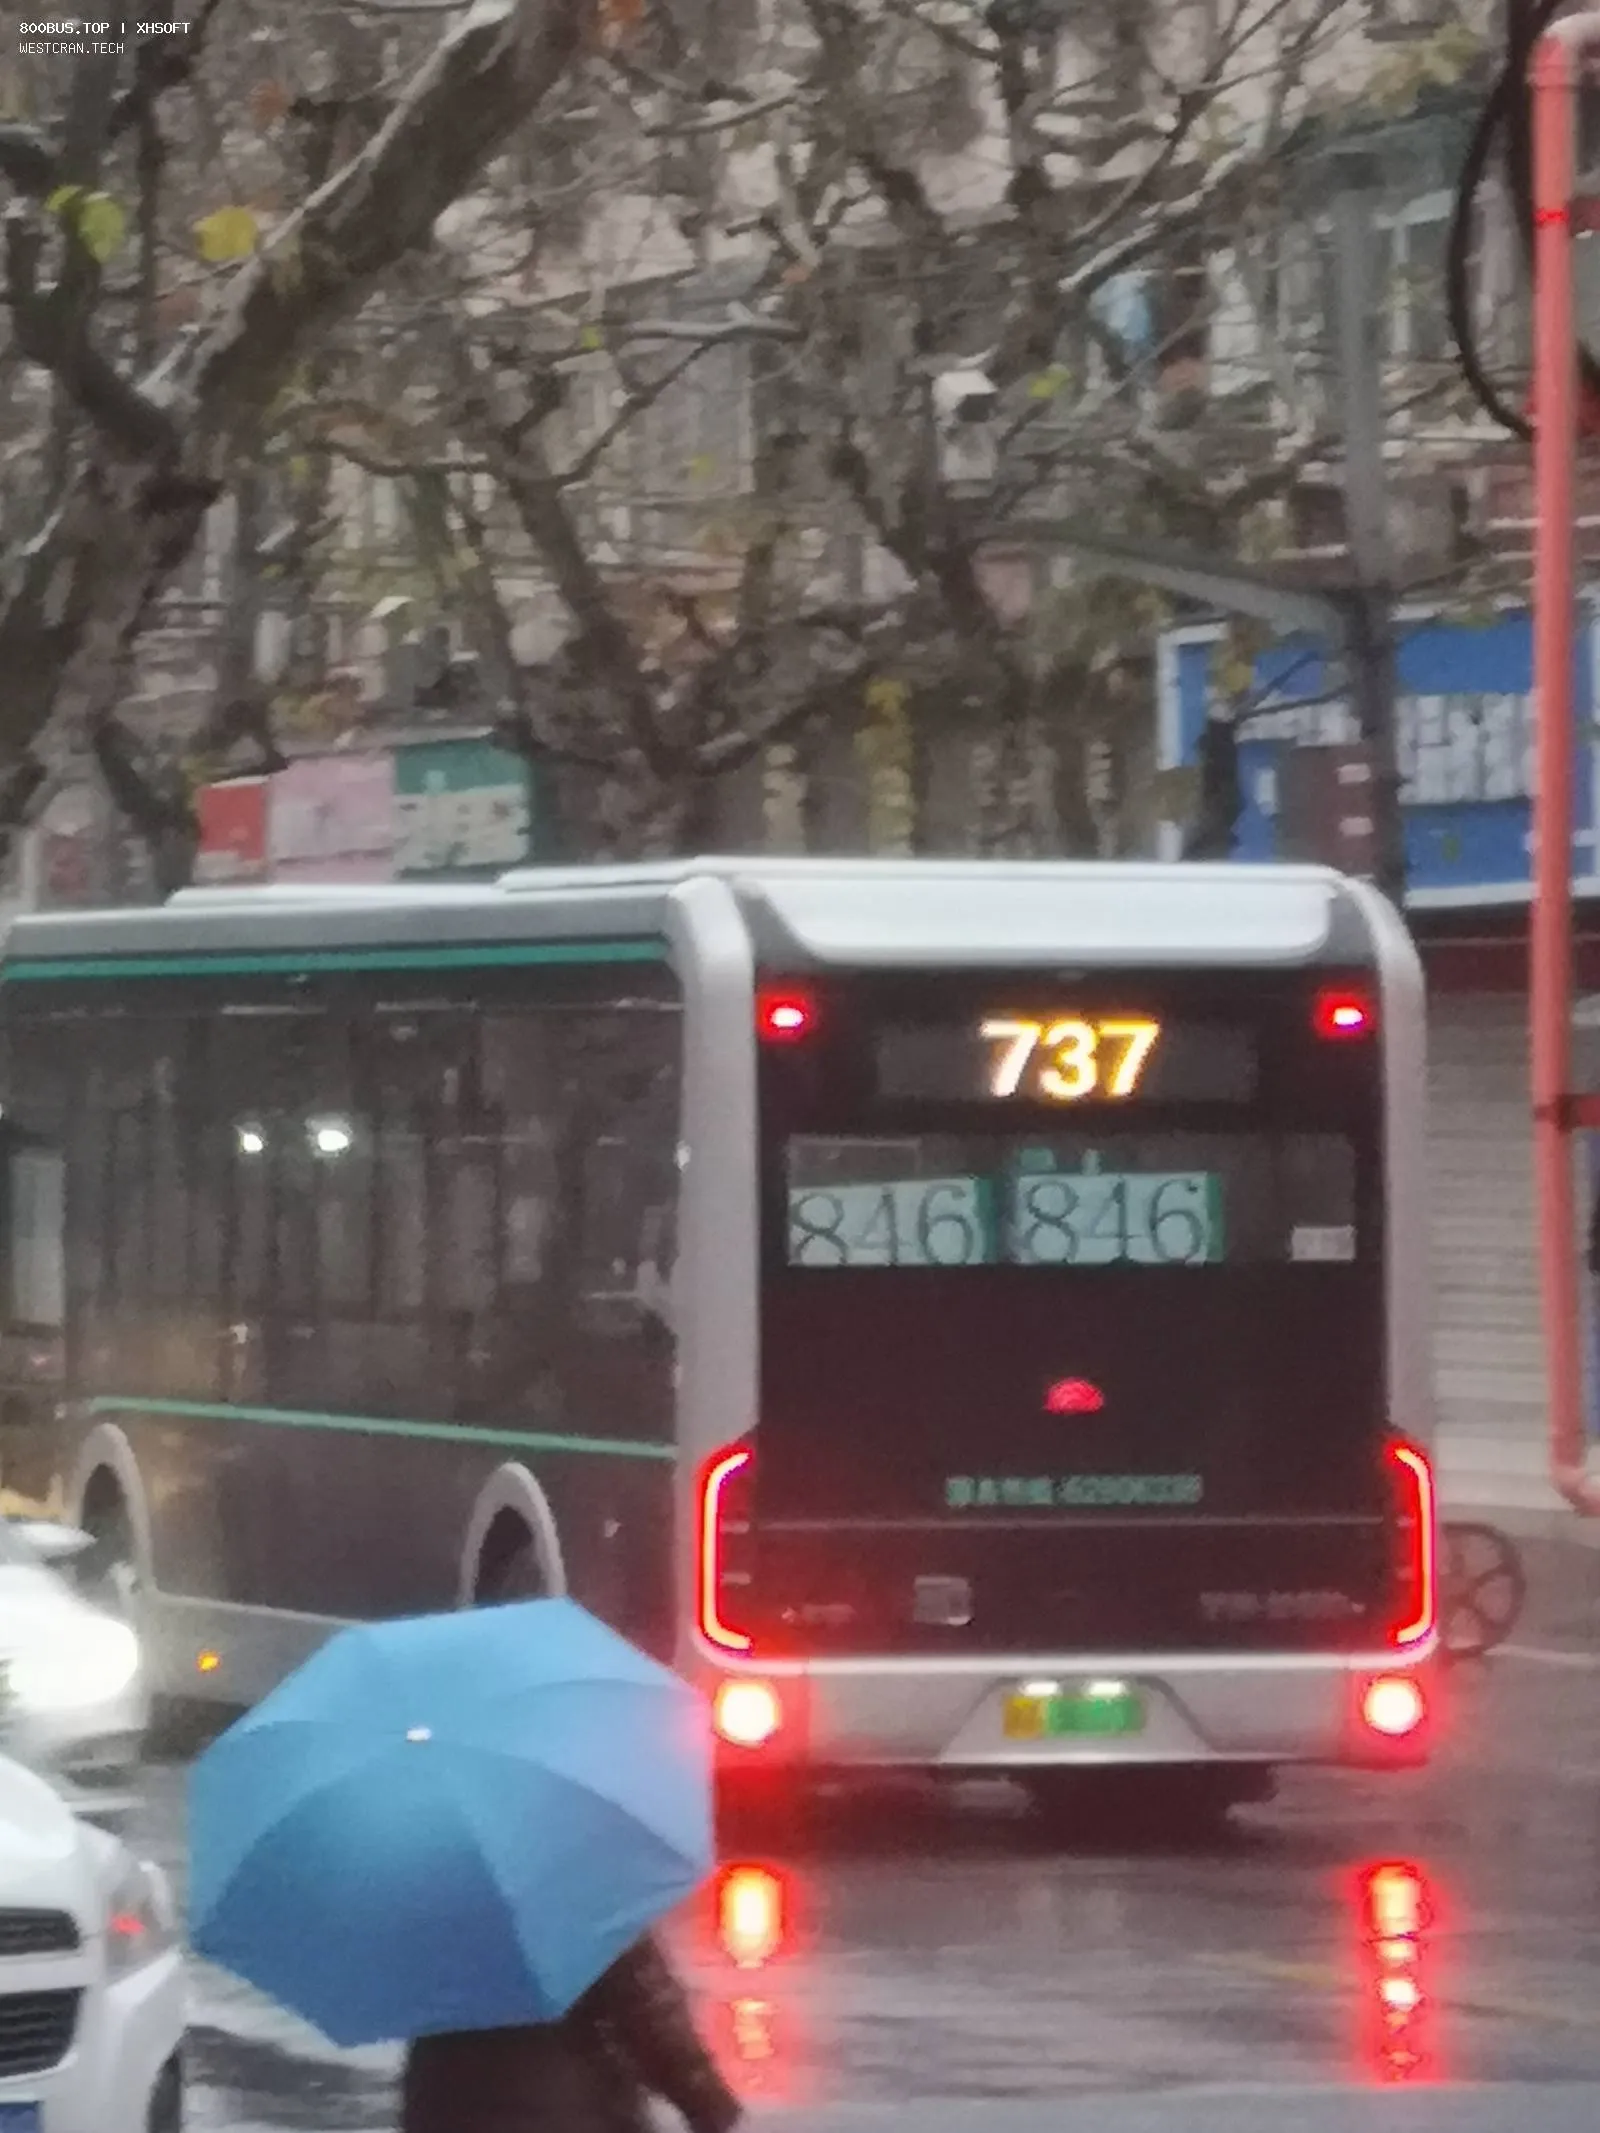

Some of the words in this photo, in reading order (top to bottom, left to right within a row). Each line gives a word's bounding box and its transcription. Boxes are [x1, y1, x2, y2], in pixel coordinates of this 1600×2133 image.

[980, 1019, 1161, 1098] 737
[791, 1185, 974, 1264] 846
[1023, 1179, 1203, 1263] 846
